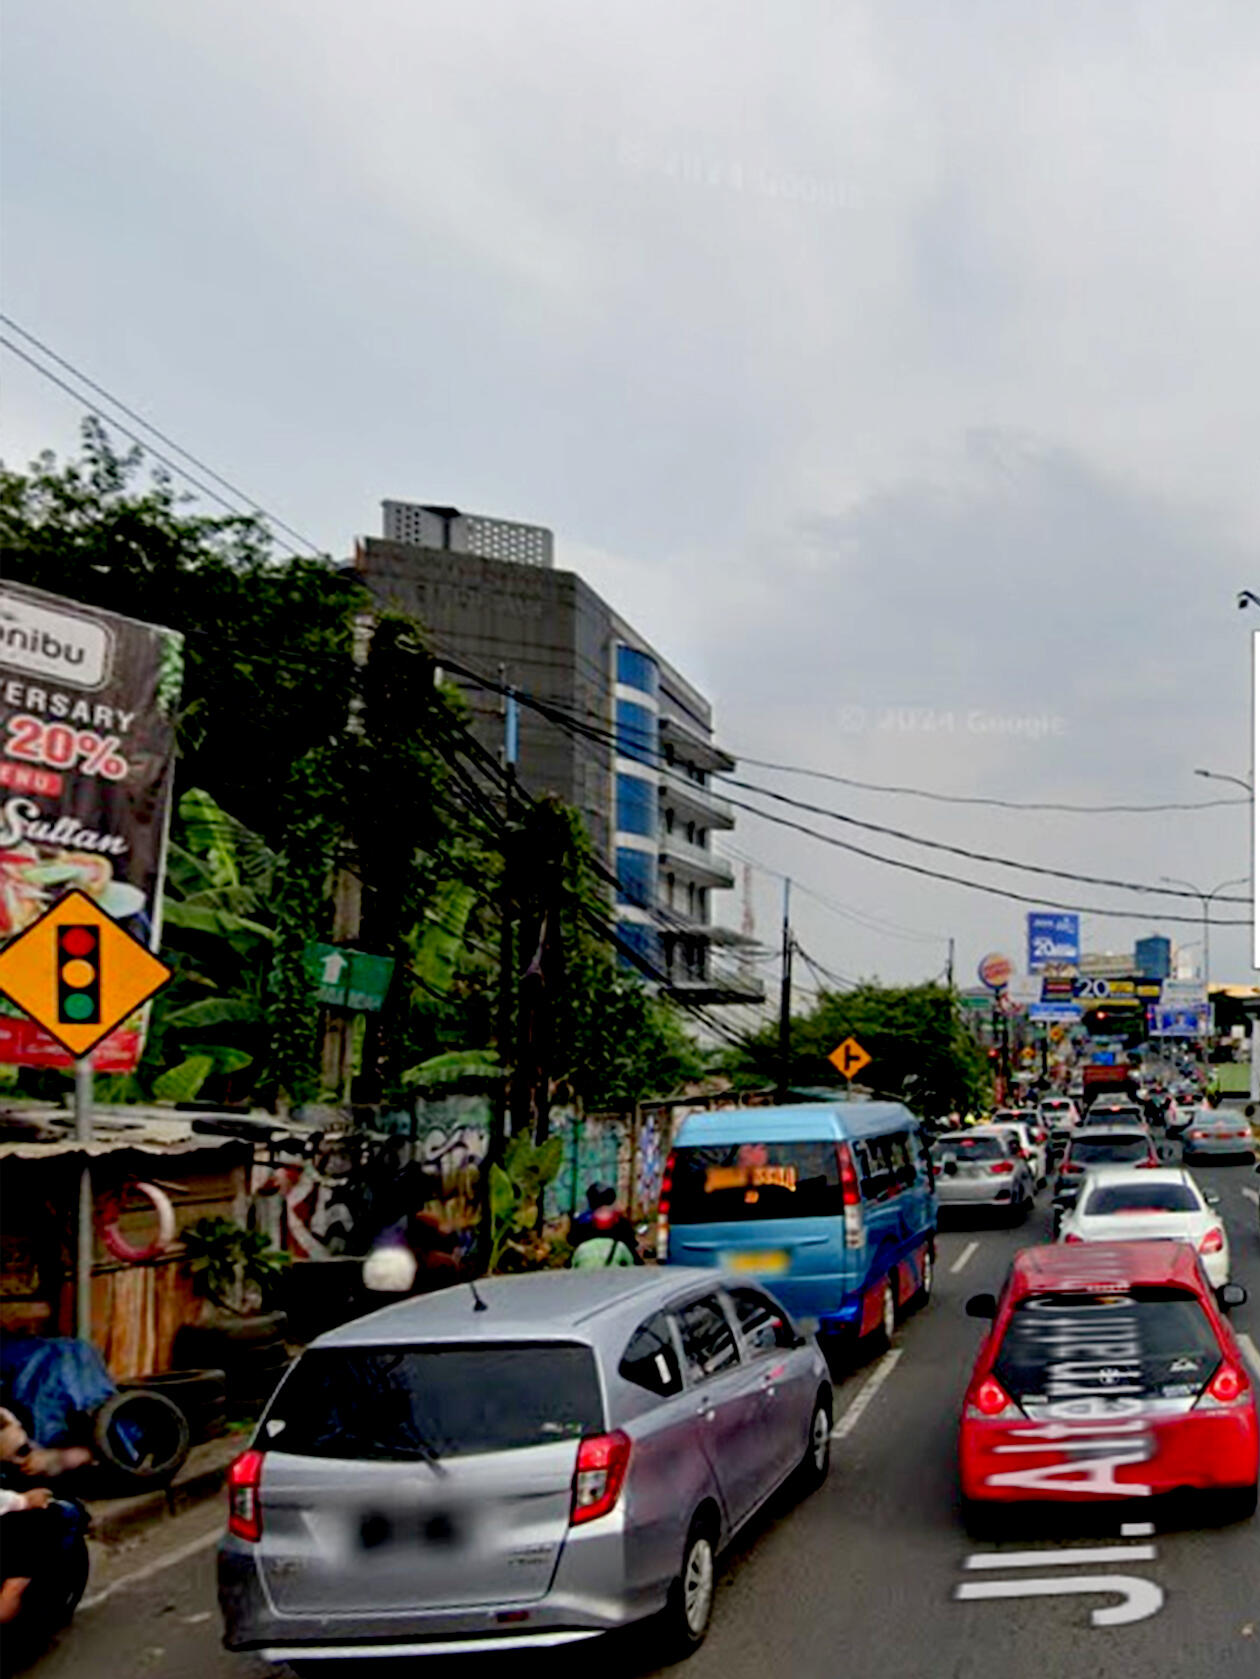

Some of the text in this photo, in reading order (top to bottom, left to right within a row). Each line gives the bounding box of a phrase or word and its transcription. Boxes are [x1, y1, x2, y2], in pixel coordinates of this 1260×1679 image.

[0, 624, 85, 665] nibu
[0, 681, 135, 732] ERSARY
[7, 714, 128, 780] 20%
[0, 797, 129, 855] Sultan
